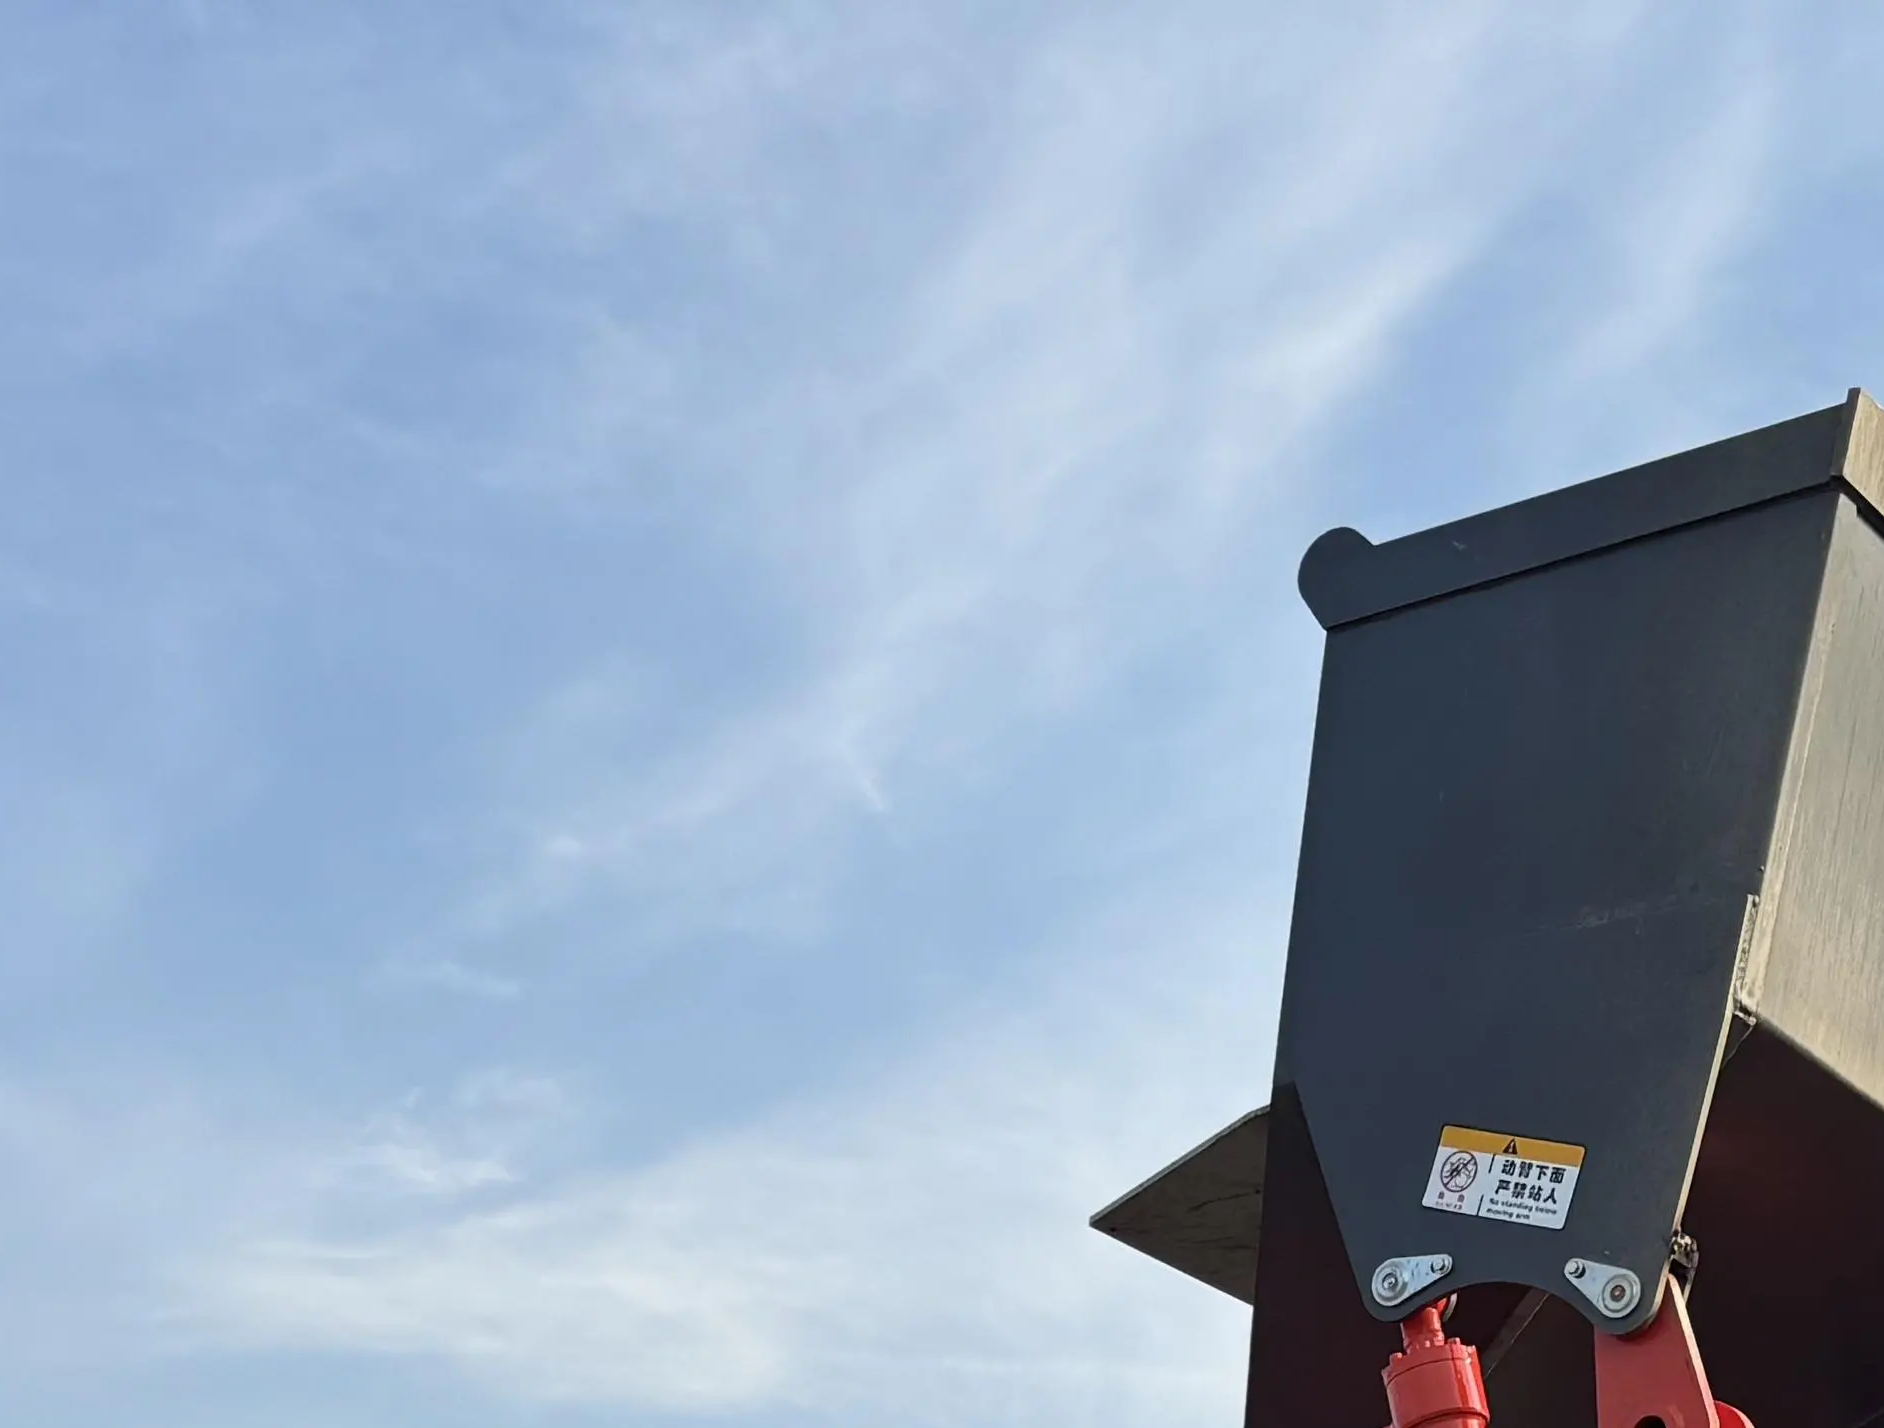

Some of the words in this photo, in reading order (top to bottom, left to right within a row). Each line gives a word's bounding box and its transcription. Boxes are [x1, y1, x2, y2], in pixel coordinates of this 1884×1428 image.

[1501, 1158, 1567, 1185] 动臂下面
[1494, 1179, 1558, 1206] 严禁站人
[1486, 1207, 1514, 1219] moving
[1501, 1200, 1533, 1213] standing
